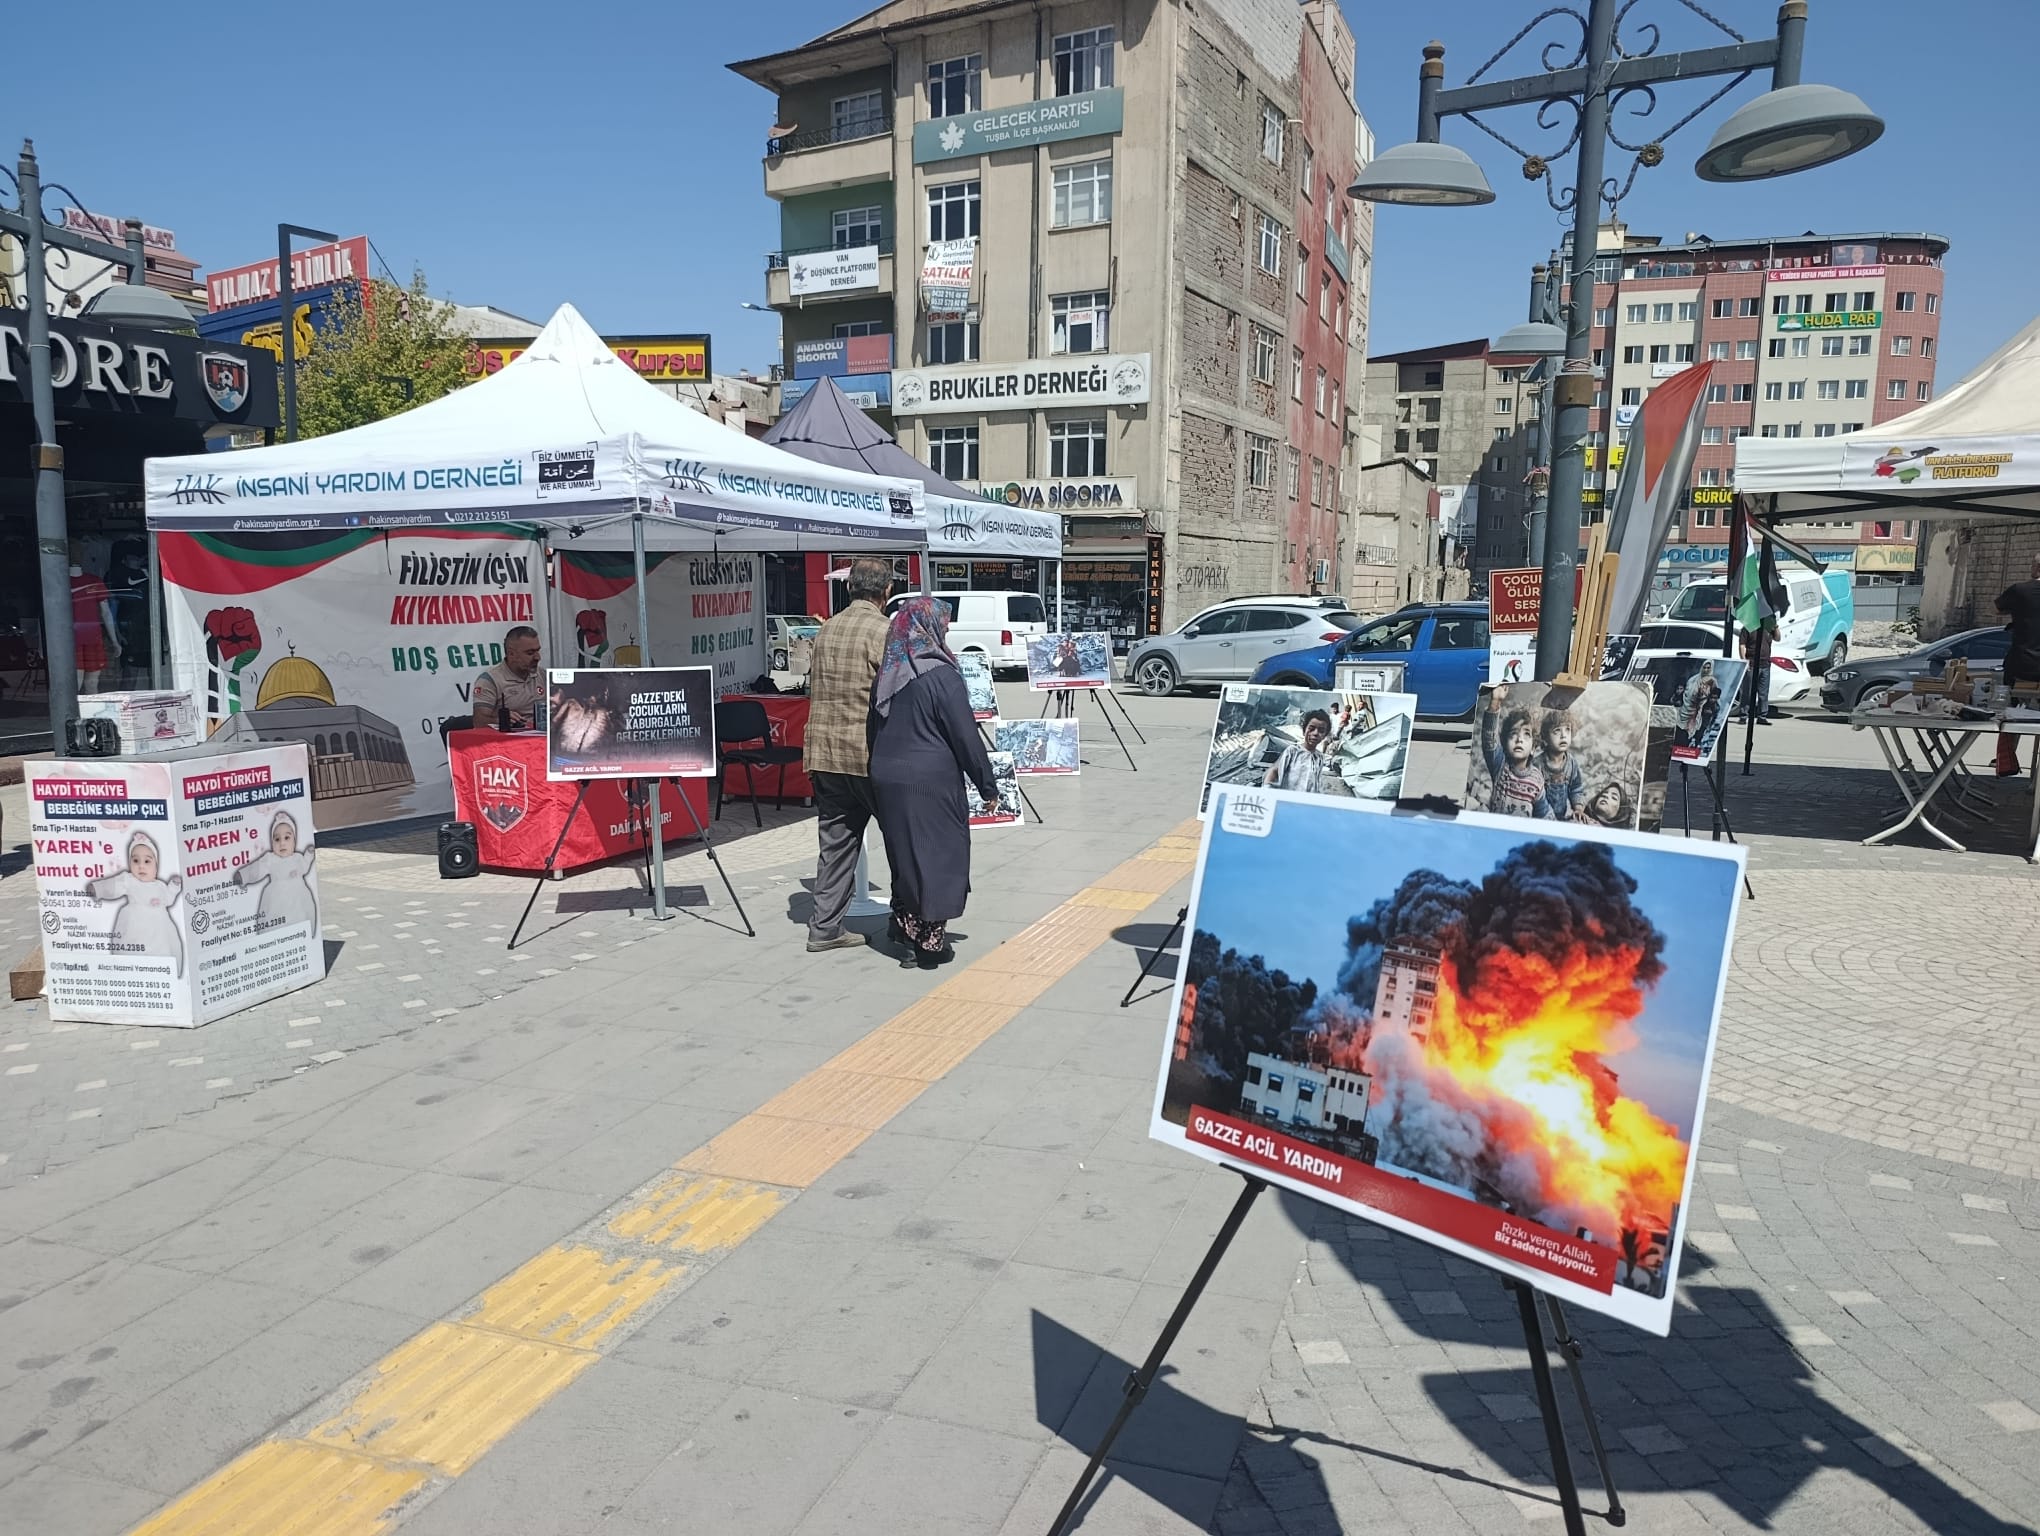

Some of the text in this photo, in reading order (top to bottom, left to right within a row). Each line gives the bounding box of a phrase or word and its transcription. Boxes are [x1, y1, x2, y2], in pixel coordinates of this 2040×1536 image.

[973, 110, 1037, 132] GELECEK
[985, 131, 1010, 144] TUŞBA
[69, 210, 113, 235] KAYA
[836, 254, 849, 262] VAN
[810, 262, 877, 278] DÜŞÜNCE PLATFORMU
[921, 267, 972, 279] SATILIK
[212, 267, 271, 307] YILMAZ
[830, 275, 857, 286] DERNEĞİ
[1849, 313, 1876, 325] PAR
[796, 341, 844, 353] ANADOLU
[617, 349, 704, 374] Kursu
[796, 351, 839, 363] SİGORTA
[539, 448, 595, 462] BİZ ÜMMETİZ
[1981, 453, 2013, 463] DESTEK
[236, 472, 309, 497] İNSANİ
[316, 471, 405, 494] YARDIM
[414, 459, 522, 490] DERNEĞİ
[1933, 465, 1999, 479] PLATFORMU
[568, 481, 595, 489] UMMAH
[718, 469, 772, 497] İNSANİ
[774, 481, 829, 505] YARDIM
[831, 490, 885, 512] DERNEĞİ
[1049, 482, 1123, 507] SİGORTA
[455, 511, 510, 522] 0212 212 5151
[982, 520, 1004, 534] İNSANİ
[1006, 522, 1029, 536] YARDIM
[399, 551, 529, 589] FİLİSTİN İÇİN
[1150, 541, 1160, 598] TEKNİK
[1186, 564, 1230, 591] OTOPARK
[1502, 574, 1542, 589] ÇOCU
[390, 594, 534, 625] KIYAMDAYIZ!
[691, 633, 715, 656] HOŞ
[392, 647, 439, 675] HOŞ
[719, 661, 736, 679] VAN
[630, 688, 685, 705] GAZZE'DEKİ
[628, 703, 687, 719] ÇOCUKLARIN
[625, 715, 691, 731] KABURGALARI
[616, 727, 701, 743] GELECEKLERİNDEN
[187, 771, 269, 794] HAYDİ TÜRKİYE
[480, 766, 521, 789] HAK
[36, 781, 125, 797] HAYDİ TÜRKİYE
[198, 783, 302, 811] BEBEĞİNE SAHİP ÇIK!
[47, 800, 165, 819] BEBEĞİNE SAHİP ÇIK!
[32, 824, 97, 834] Sma Tip-1 Hastası
[182, 814, 244, 832] Sma Tip-1 Hastası
[34, 840, 114, 854] YAREN 'e
[184, 827, 258, 853] YAREN 'e
[37, 863, 105, 878] umut ol!
[186, 851, 250, 878] umut ol!
[48, 900, 66, 908] 0541
[83, 900, 92, 908] 74
[198, 897, 215, 906] 0541
[231, 889, 239, 897] 74
[52, 941, 81, 952] Faaliyet
[82, 941, 95, 950] No:
[201, 934, 230, 948] Faaliyet
[231, 930, 243, 940] No:
[134, 964, 171, 975] Yamandağ
[1194, 1116, 1343, 1184] GAZZE ACİL YARDIM
[1501, 1221, 1594, 1264] Rızkı veren Allah.
[1494, 1230, 1598, 1277] Biz sadece taşıyoruz.
